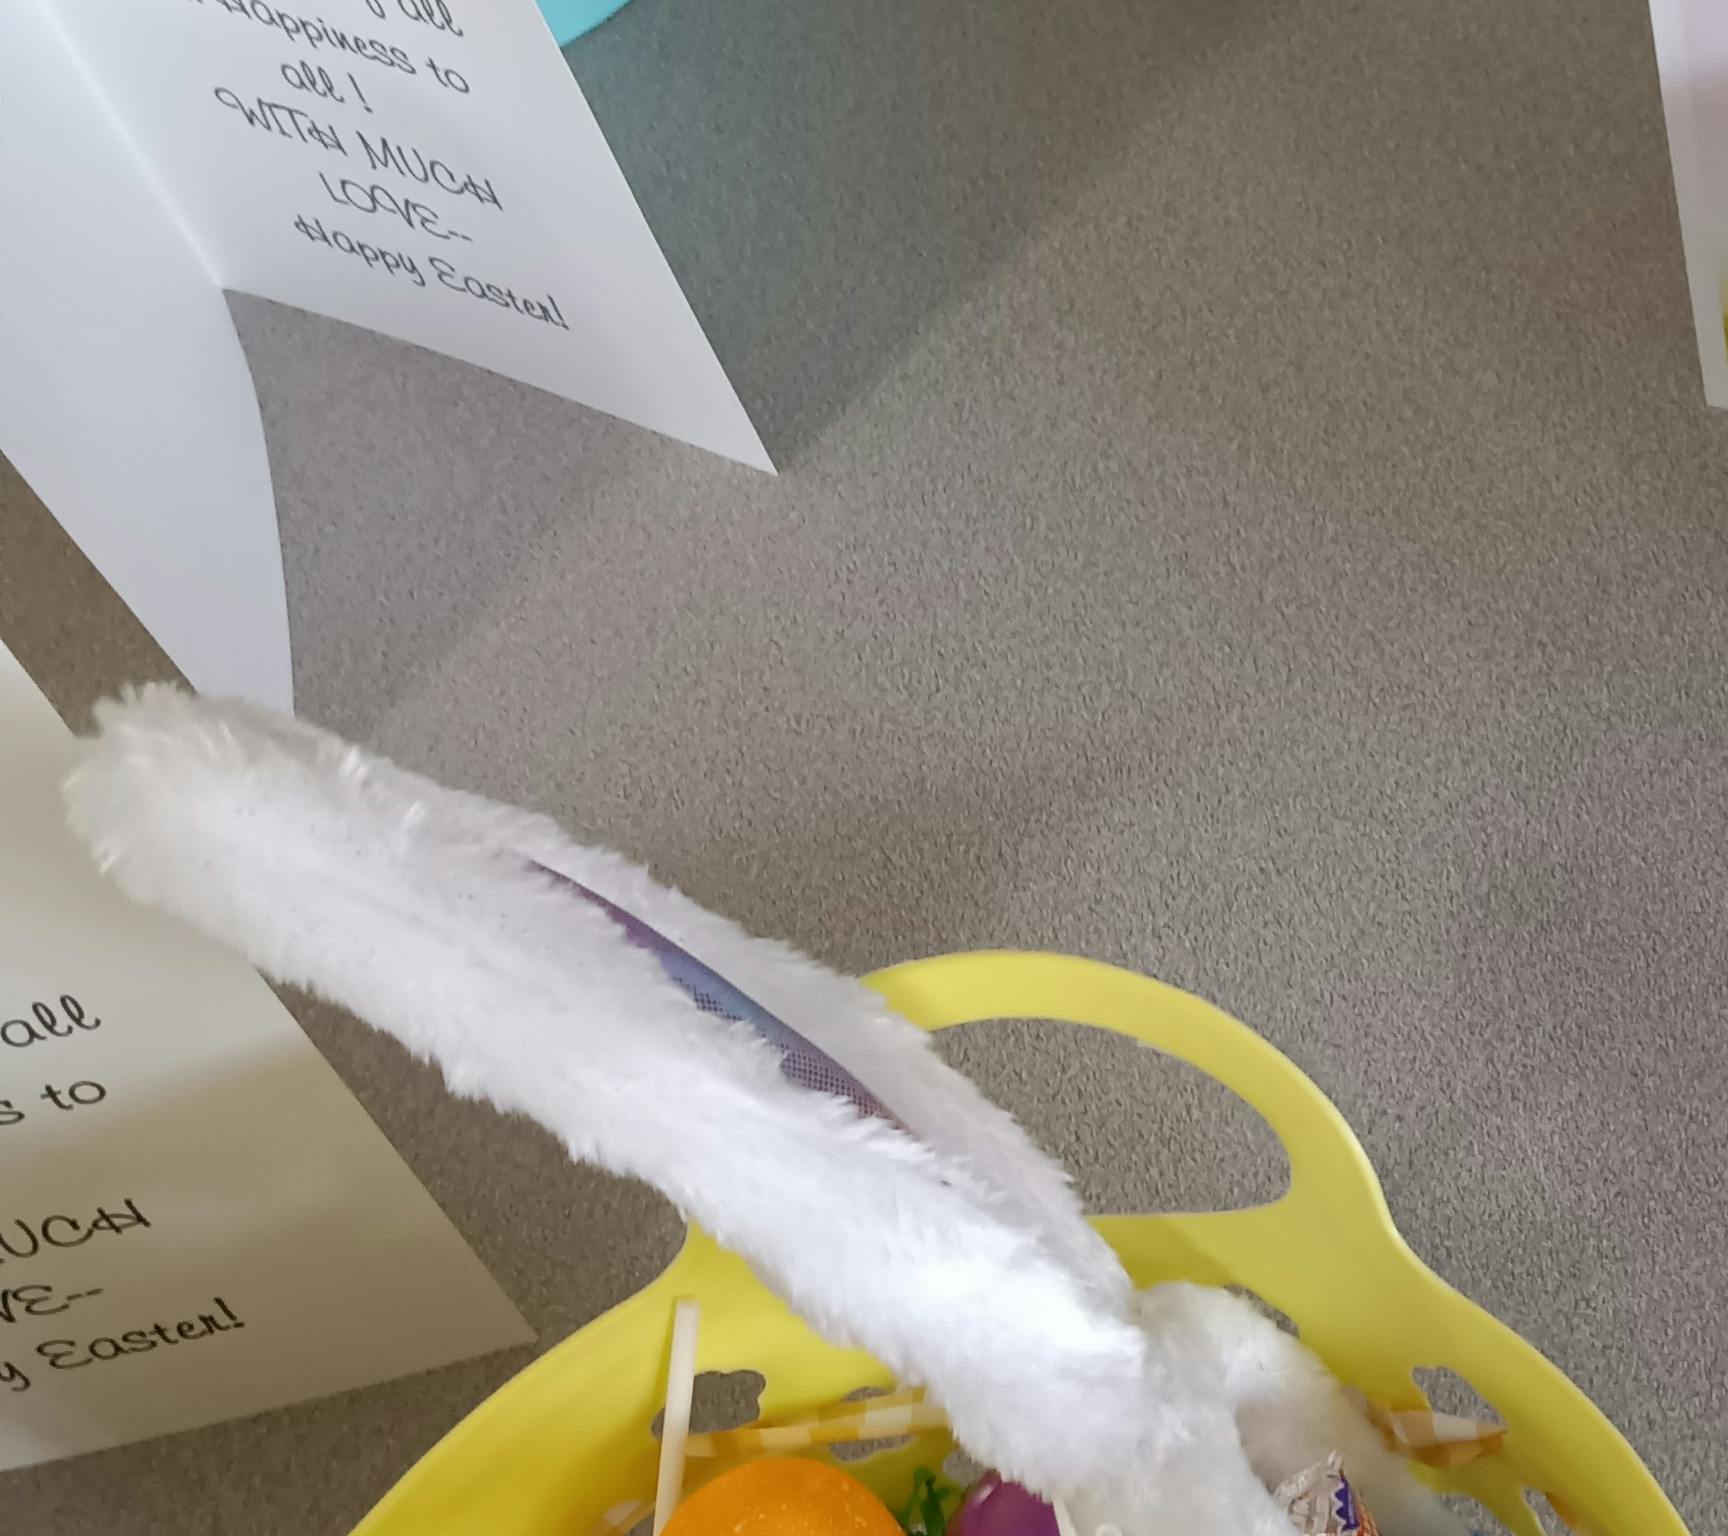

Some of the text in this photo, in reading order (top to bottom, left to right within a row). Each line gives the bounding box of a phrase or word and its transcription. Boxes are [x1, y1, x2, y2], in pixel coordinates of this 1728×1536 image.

[426, 58, 470, 94] to
[214, 87, 503, 211] WITH MUCH
[294, 214, 570, 331] Happy Easter!
[0, 994, 101, 1048] all
[40, 1080, 107, 1111] to
[0, 1198, 151, 1264] UCH
[36, 1296, 245, 1370] Easter!
